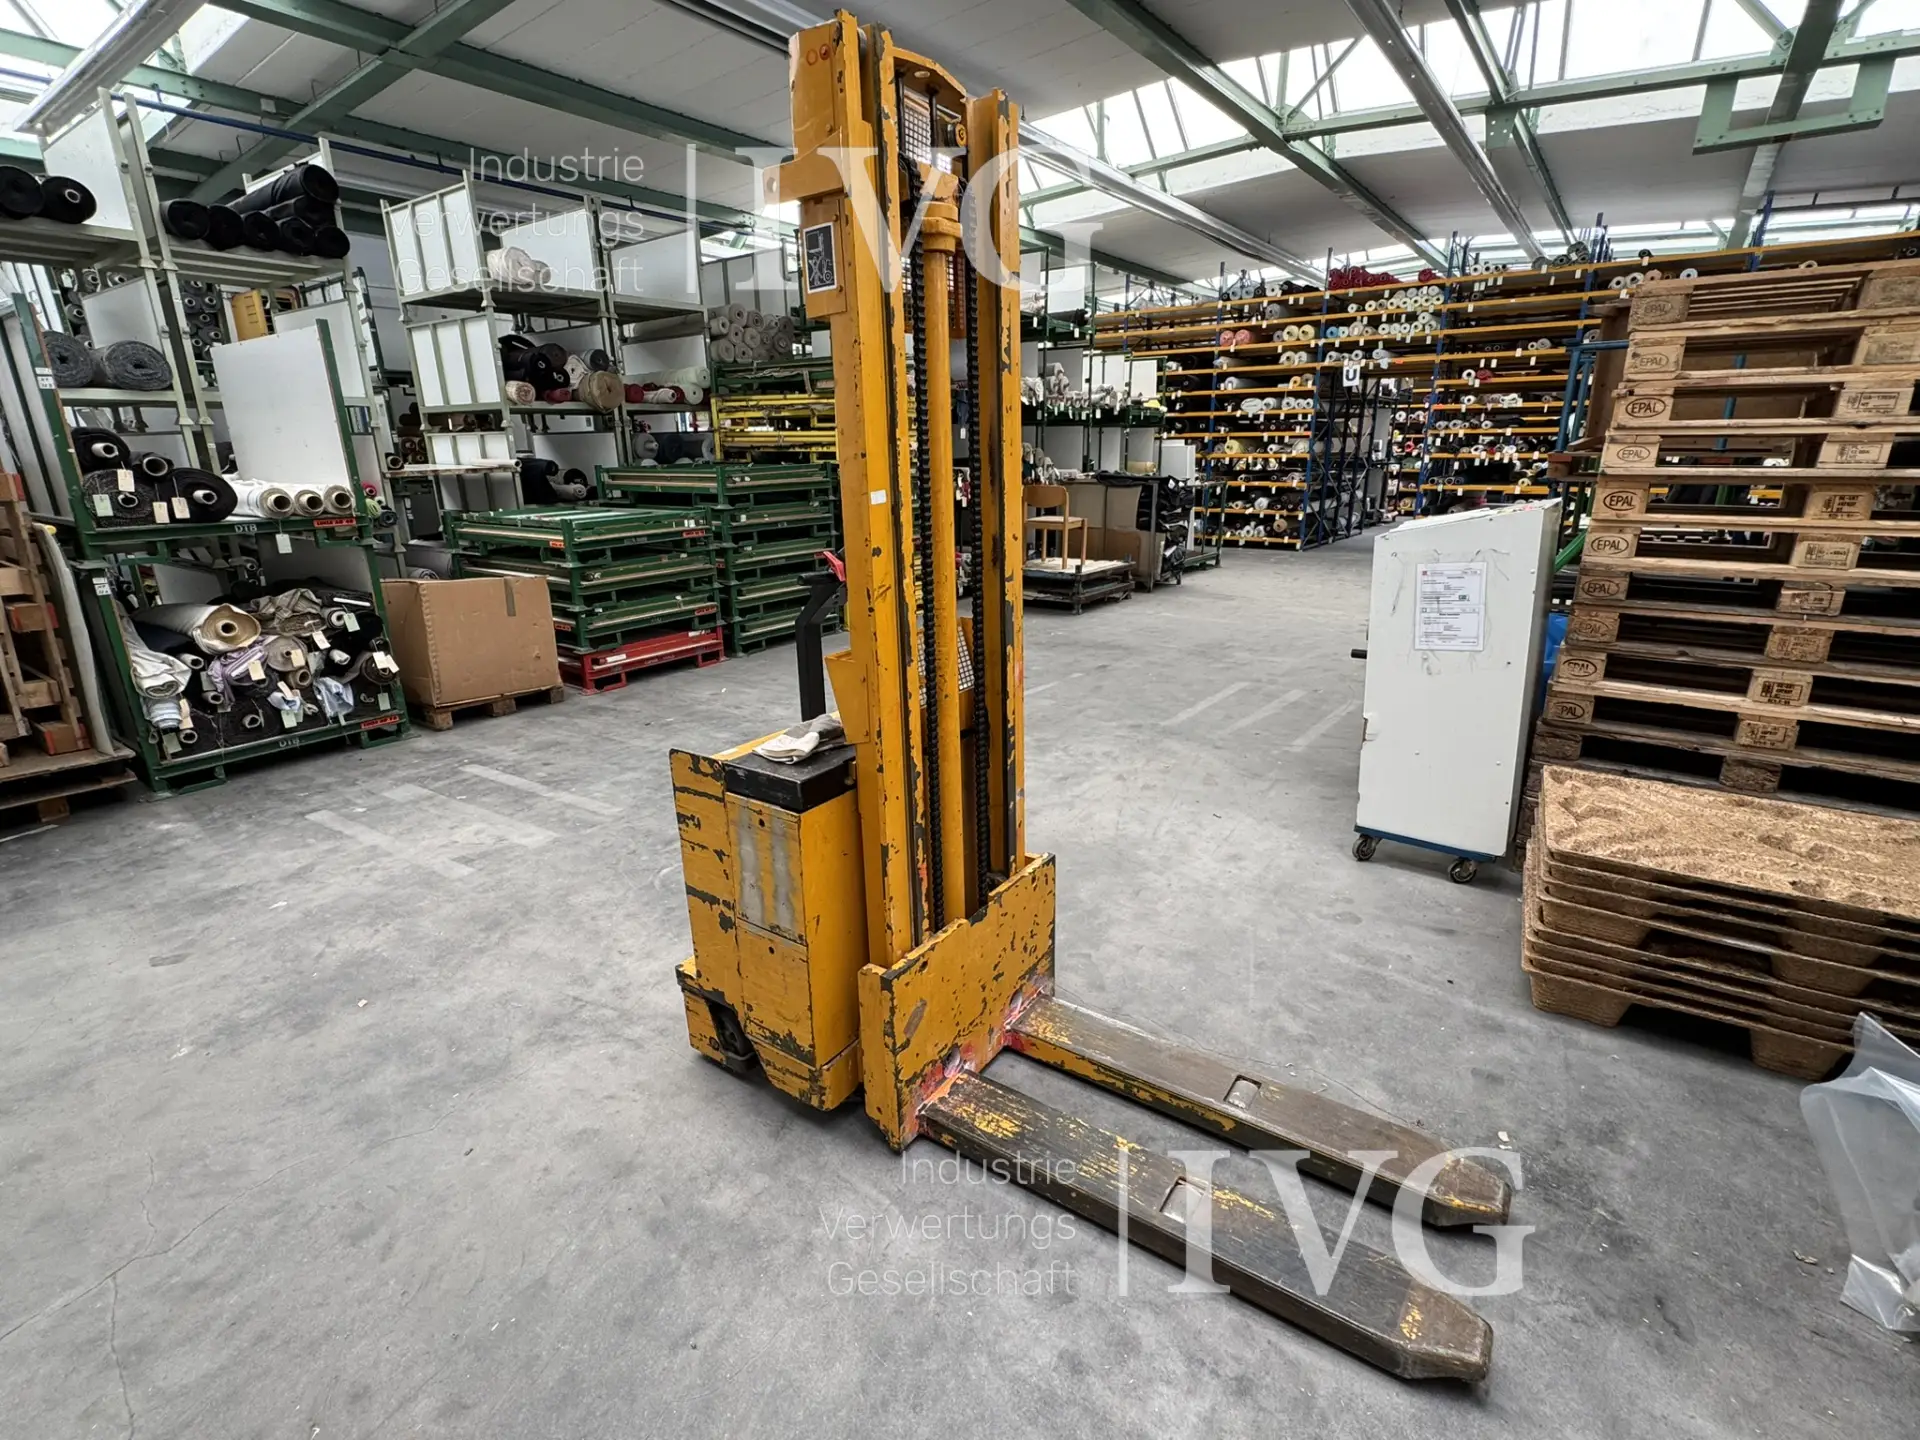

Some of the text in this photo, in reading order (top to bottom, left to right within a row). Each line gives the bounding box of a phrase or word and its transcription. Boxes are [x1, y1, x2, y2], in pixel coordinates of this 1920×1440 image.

[1640, 356, 1664, 367] EPAL
[1345, 368, 1358, 382] U
[1630, 402, 1660, 414] EPAL
[1621, 449, 1645, 459] EPAL
[1608, 495, 1635, 507] EPAL
[234, 524, 258, 534] DTB
[1596, 539, 1623, 551] EPAL
[1586, 582, 1613, 595] EPAL
